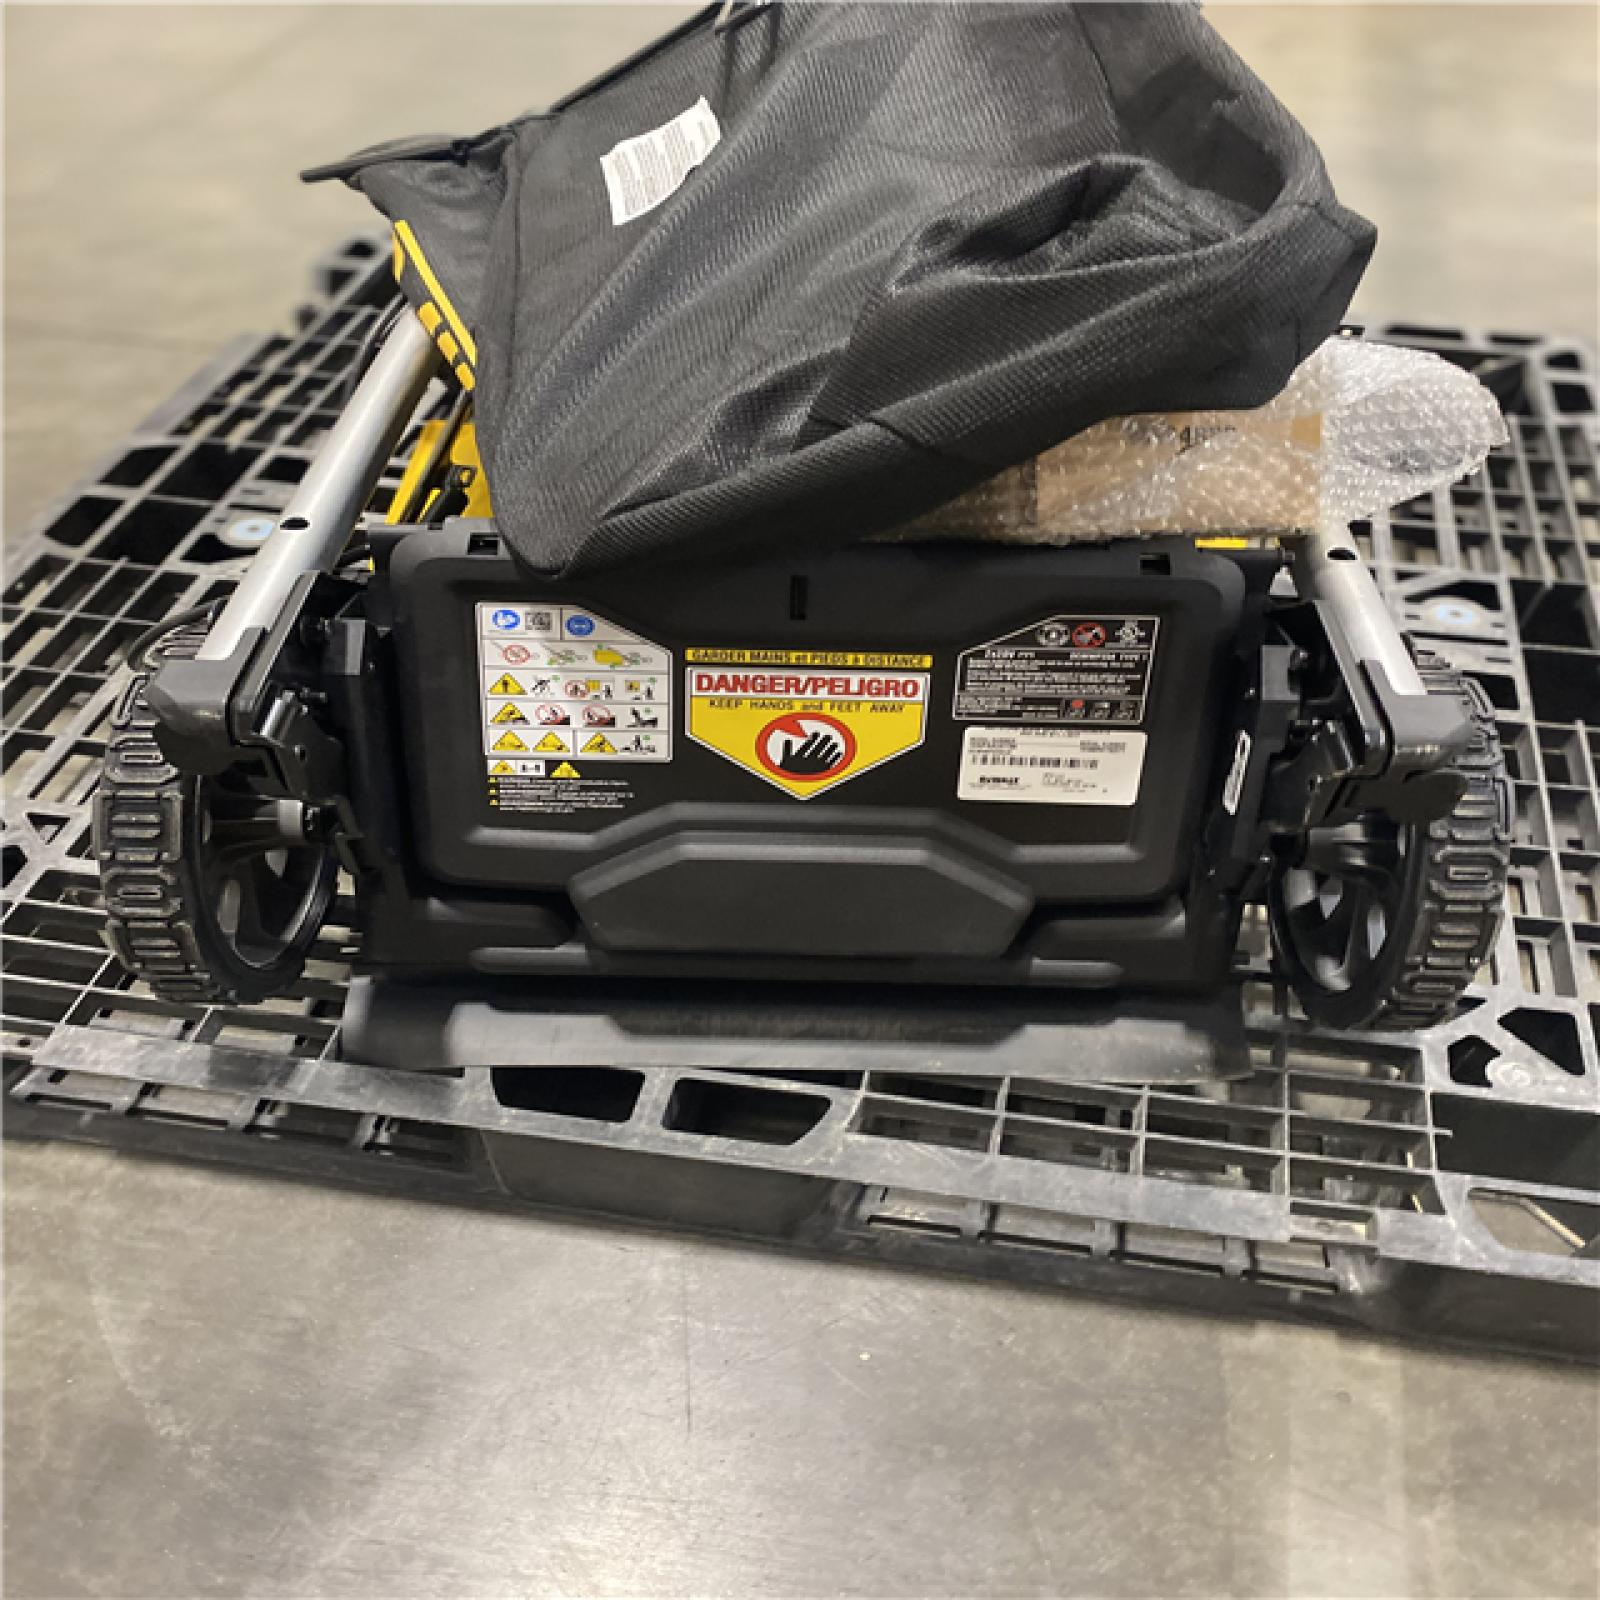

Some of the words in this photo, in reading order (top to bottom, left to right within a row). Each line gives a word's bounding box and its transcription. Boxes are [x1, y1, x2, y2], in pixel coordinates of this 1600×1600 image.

[750, 650, 791, 664] MAINS
[695, 673, 919, 698] DANGER/PELIGRO
[709, 698, 743, 709] KEEP
[749, 699, 793, 711] HANDS
[829, 700, 861, 713] FEET
[869, 702, 904, 714] AWAY
